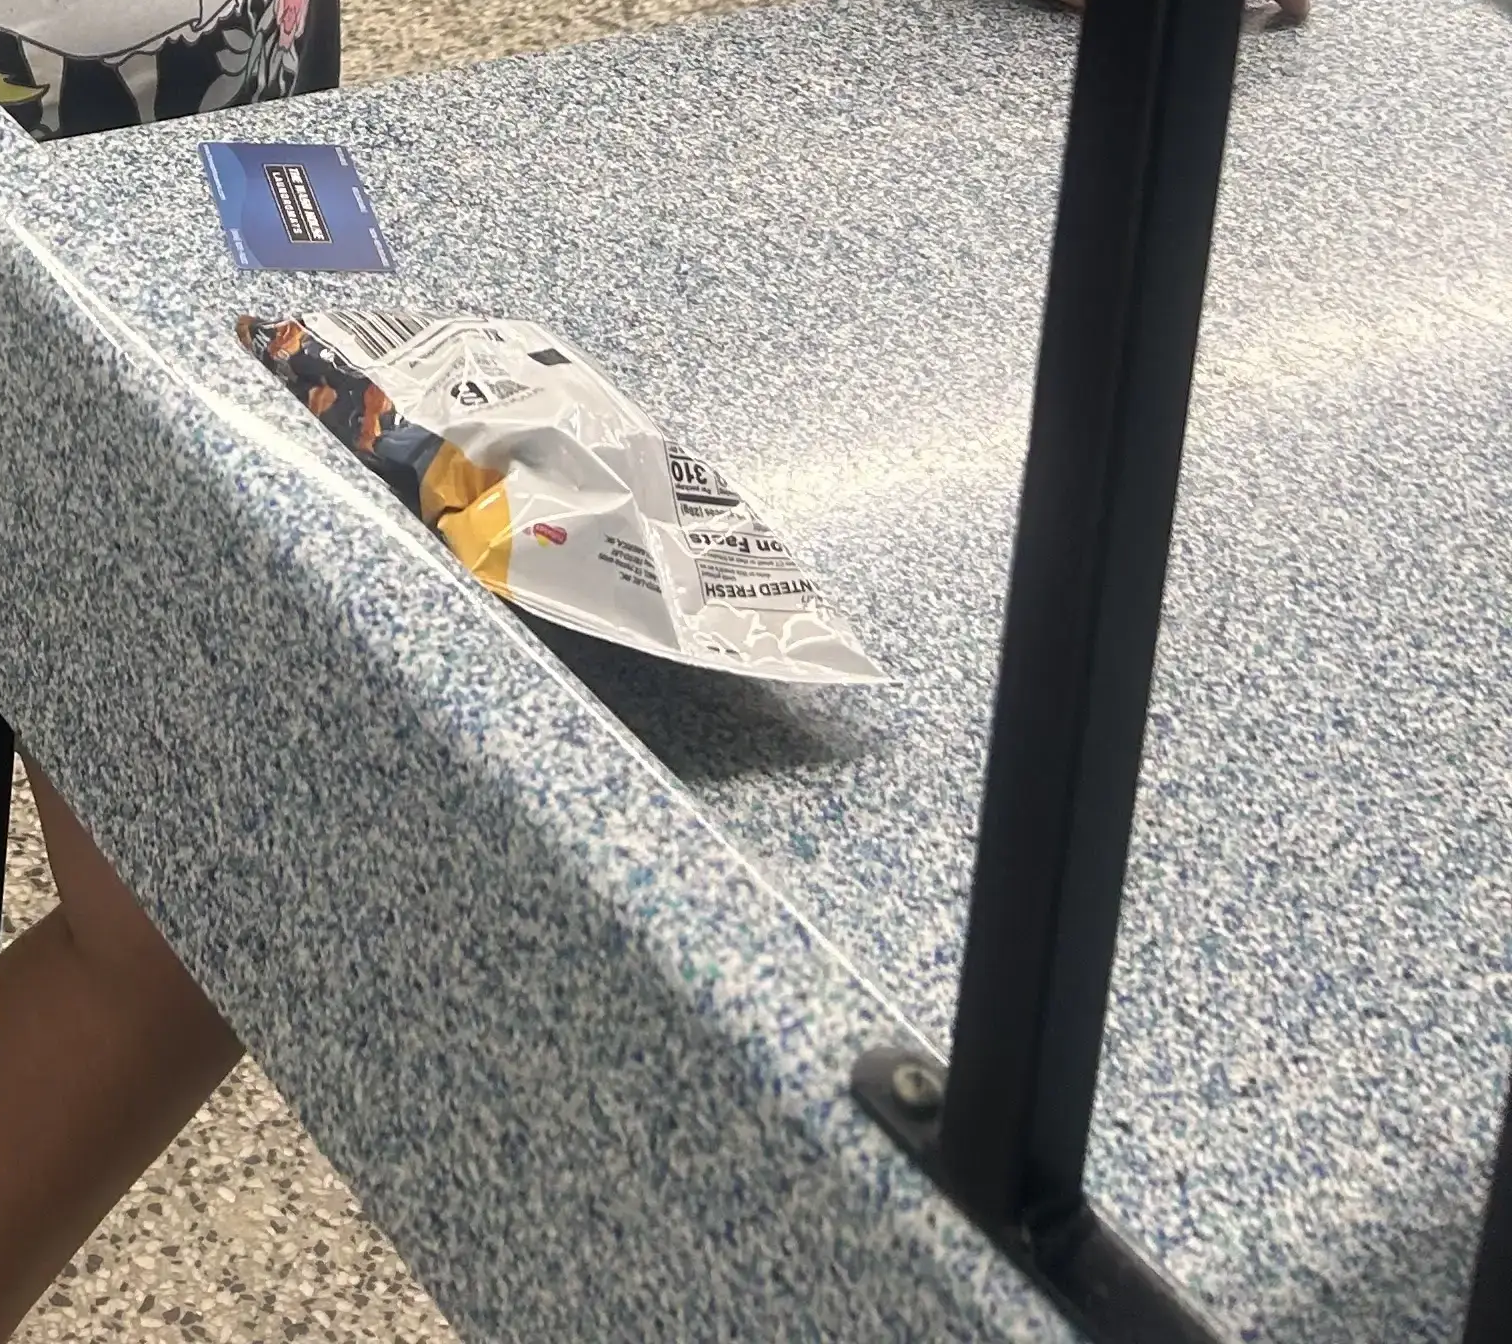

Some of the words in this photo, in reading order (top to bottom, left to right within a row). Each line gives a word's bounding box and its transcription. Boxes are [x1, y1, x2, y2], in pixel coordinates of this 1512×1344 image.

[671, 460, 708, 484] 310
[688, 533, 750, 554] Facts
[704, 582, 756, 598] FRESH
[759, 578, 813, 597] NTEED
